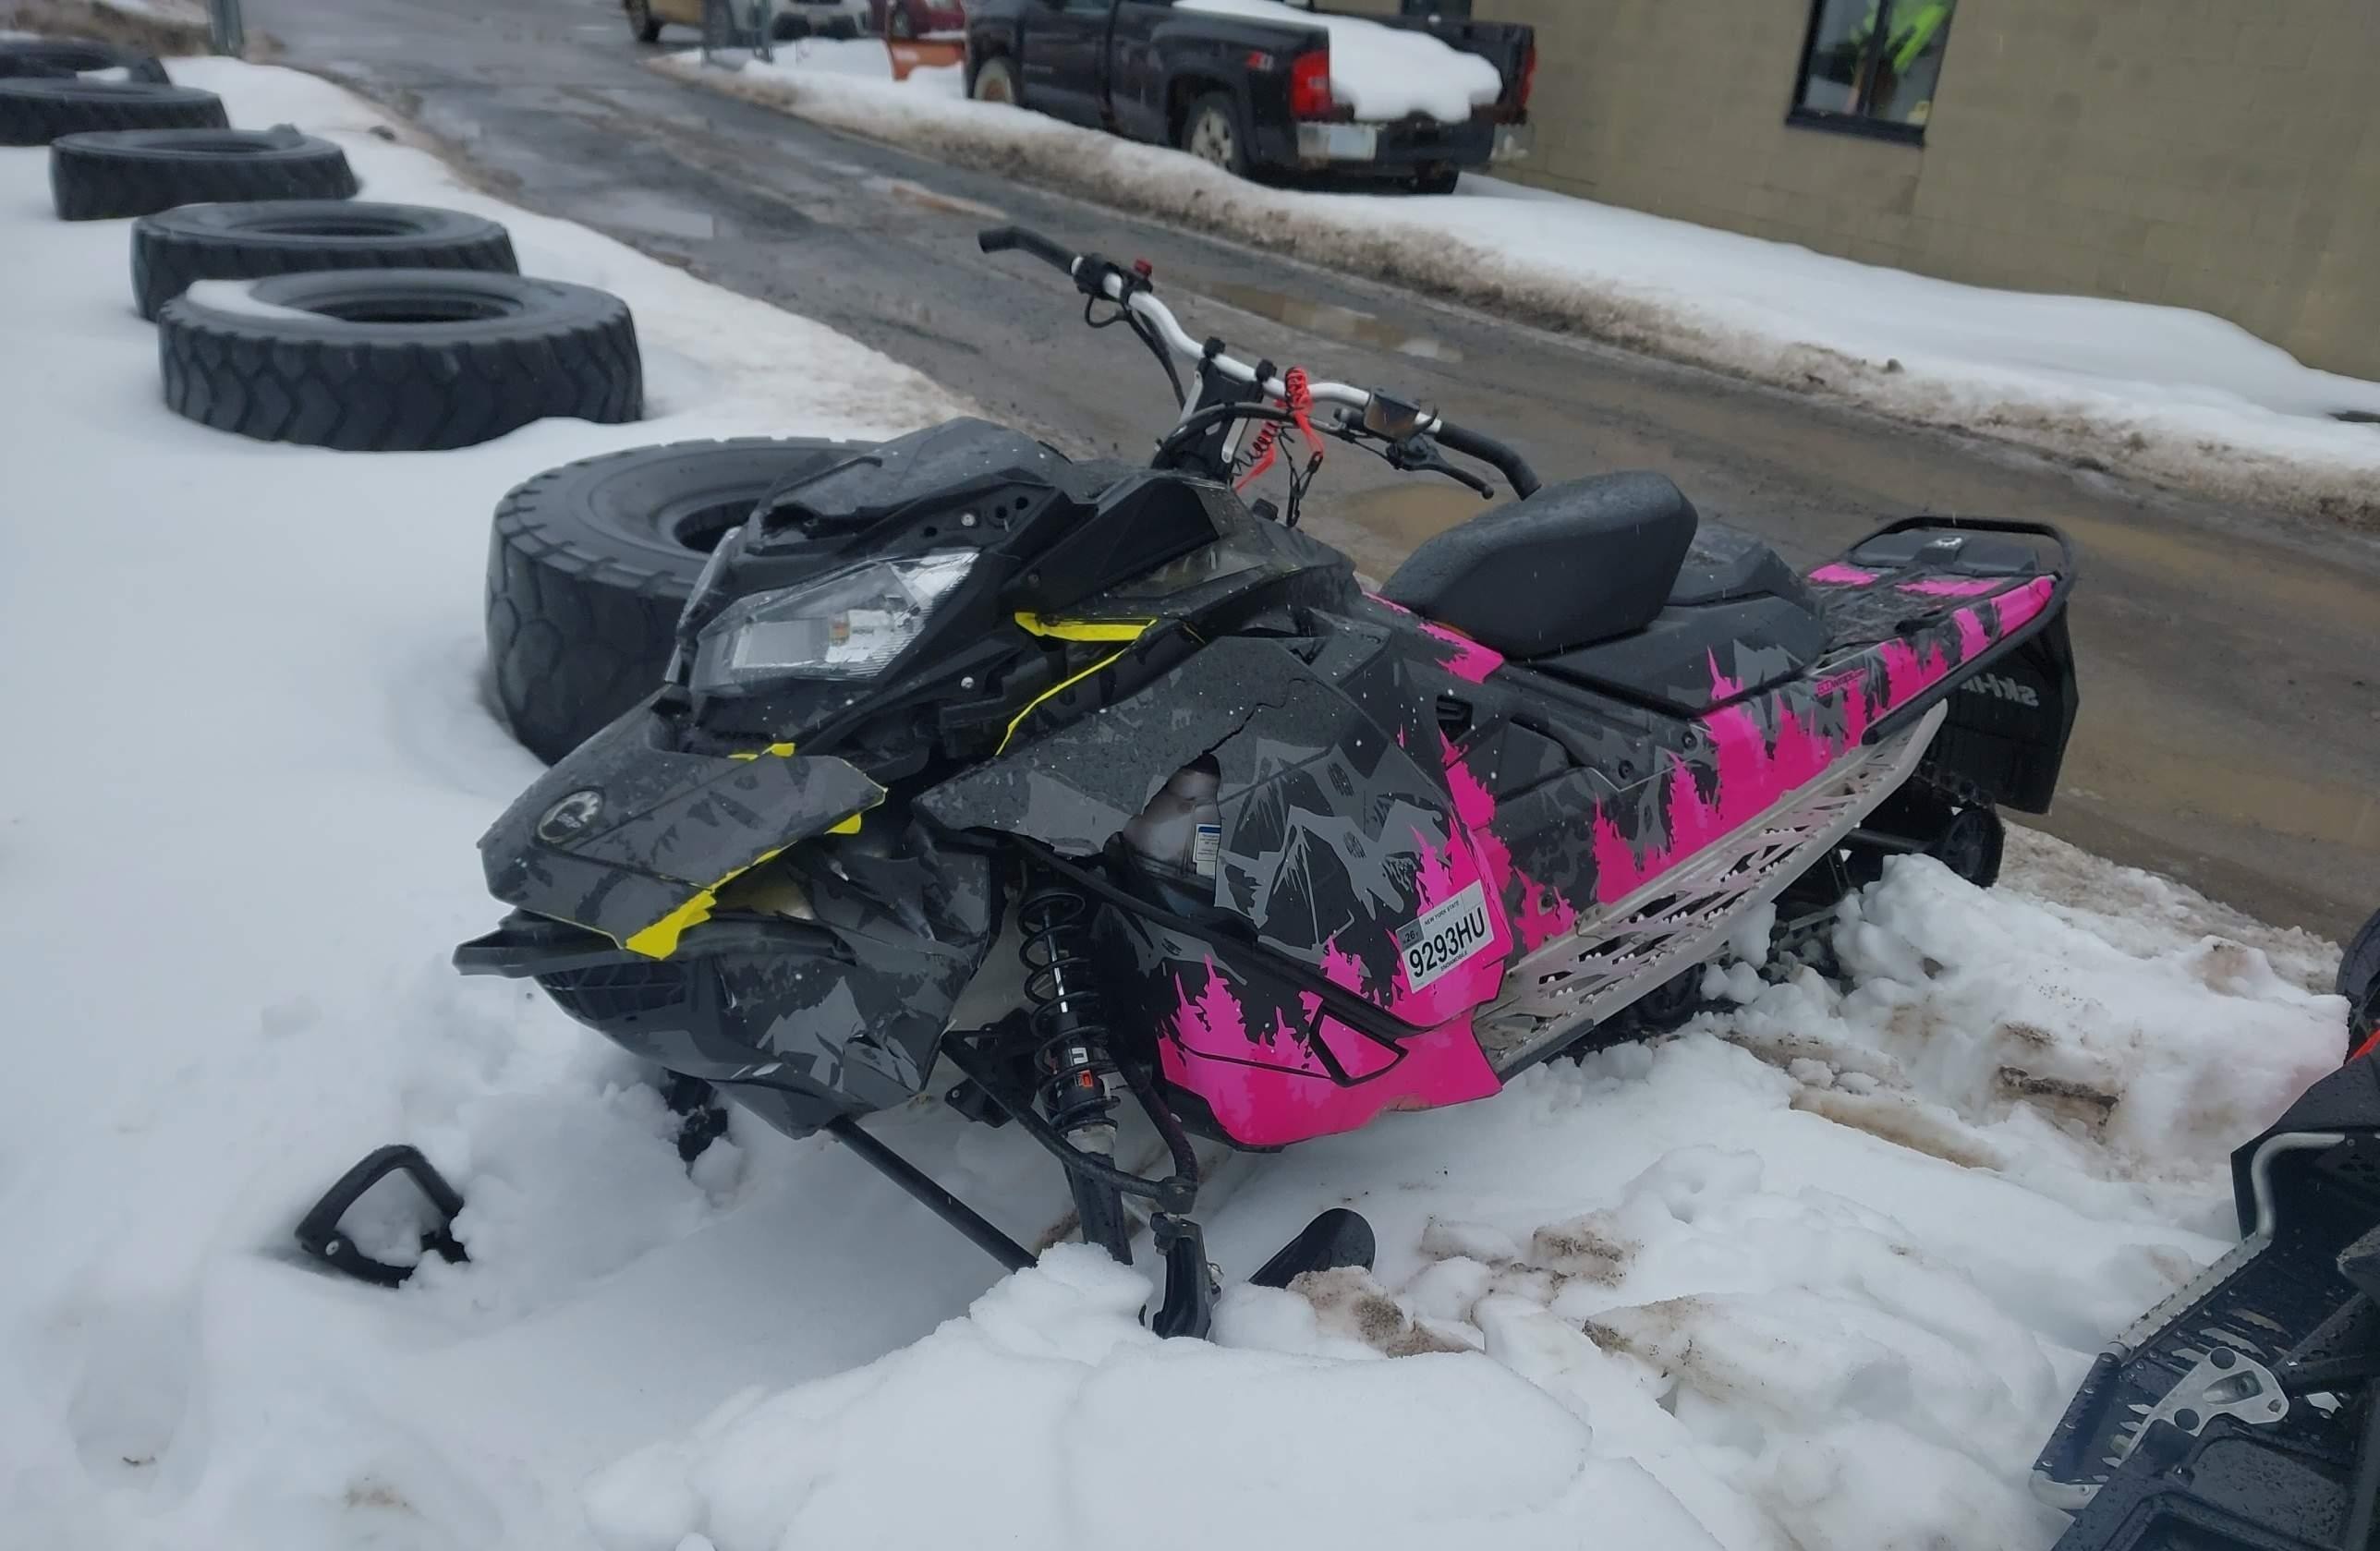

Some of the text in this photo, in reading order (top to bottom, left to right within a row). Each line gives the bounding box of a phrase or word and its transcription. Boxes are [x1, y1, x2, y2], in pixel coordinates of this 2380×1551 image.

[1424, 916, 1435, 925] NEW
[1435, 908, 1448, 919] YORK
[1404, 930, 1415, 942] 26
[1409, 906, 1486, 978] 9293HU
